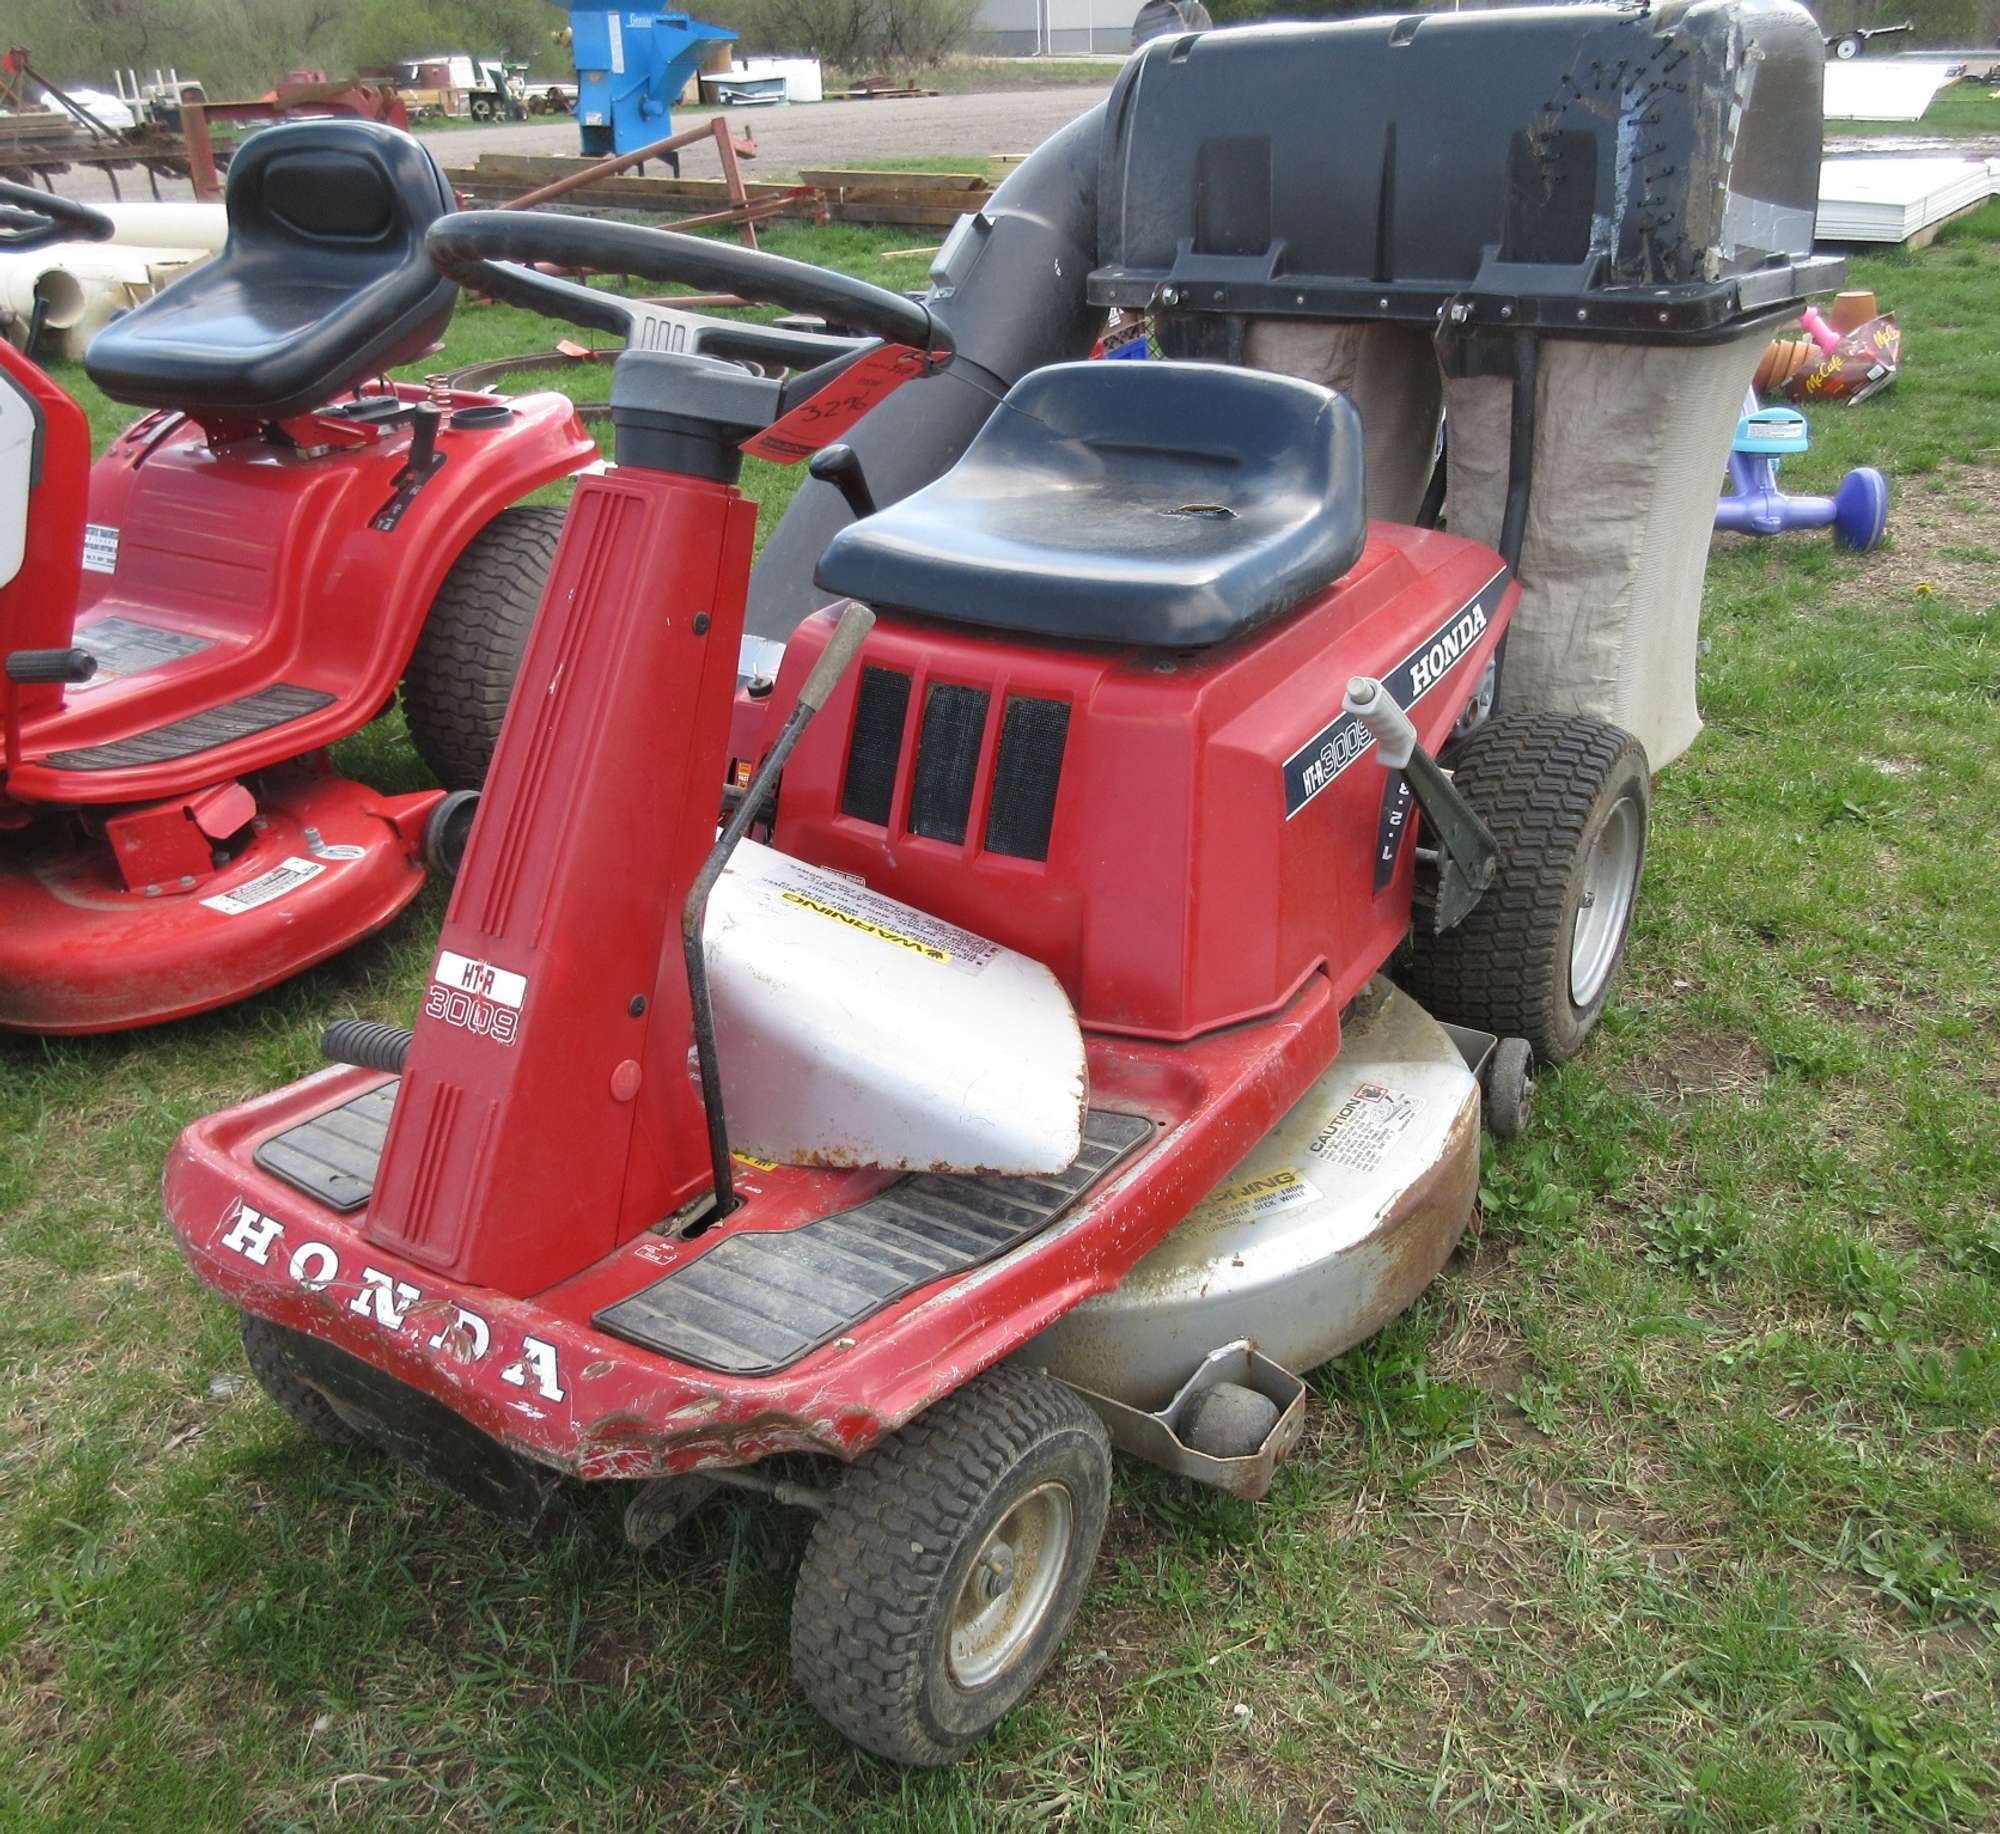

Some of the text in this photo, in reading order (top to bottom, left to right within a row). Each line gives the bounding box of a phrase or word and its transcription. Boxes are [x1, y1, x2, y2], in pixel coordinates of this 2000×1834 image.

[1409, 603, 1487, 697] HONDA
[782, 892, 923, 952] WARNING
[461, 963, 495, 995] HT-R
[426, 985, 518, 1043] 3009
[1310, 1099, 1361, 1152] CAUTION
[221, 1205, 565, 1403] HONDA
